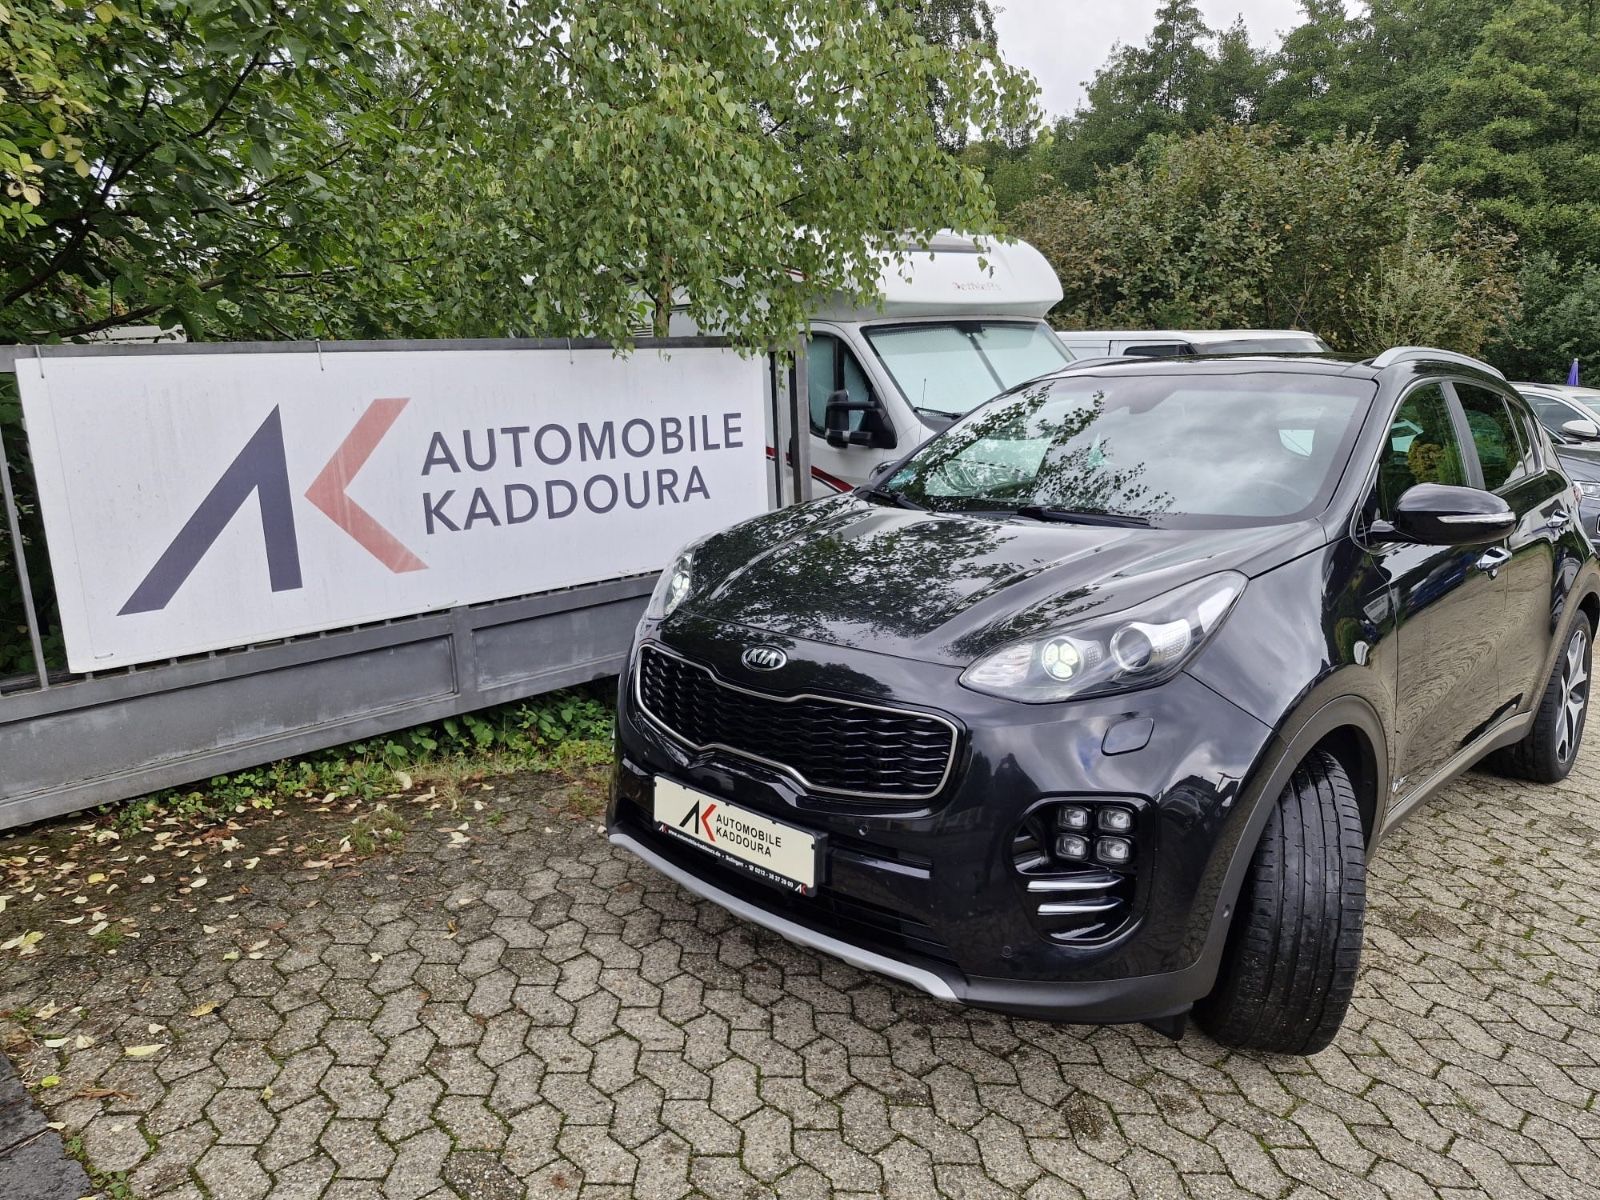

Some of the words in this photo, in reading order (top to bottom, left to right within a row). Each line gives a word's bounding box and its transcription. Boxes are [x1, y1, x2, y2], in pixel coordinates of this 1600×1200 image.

[421, 412, 743, 476] AUTOMOBILE
[422, 465, 711, 535] KADDOURA
[746, 648, 778, 667] KIA
[716, 814, 782, 847] AUTOMOBILE
[716, 826, 772, 857] KADDOURA
